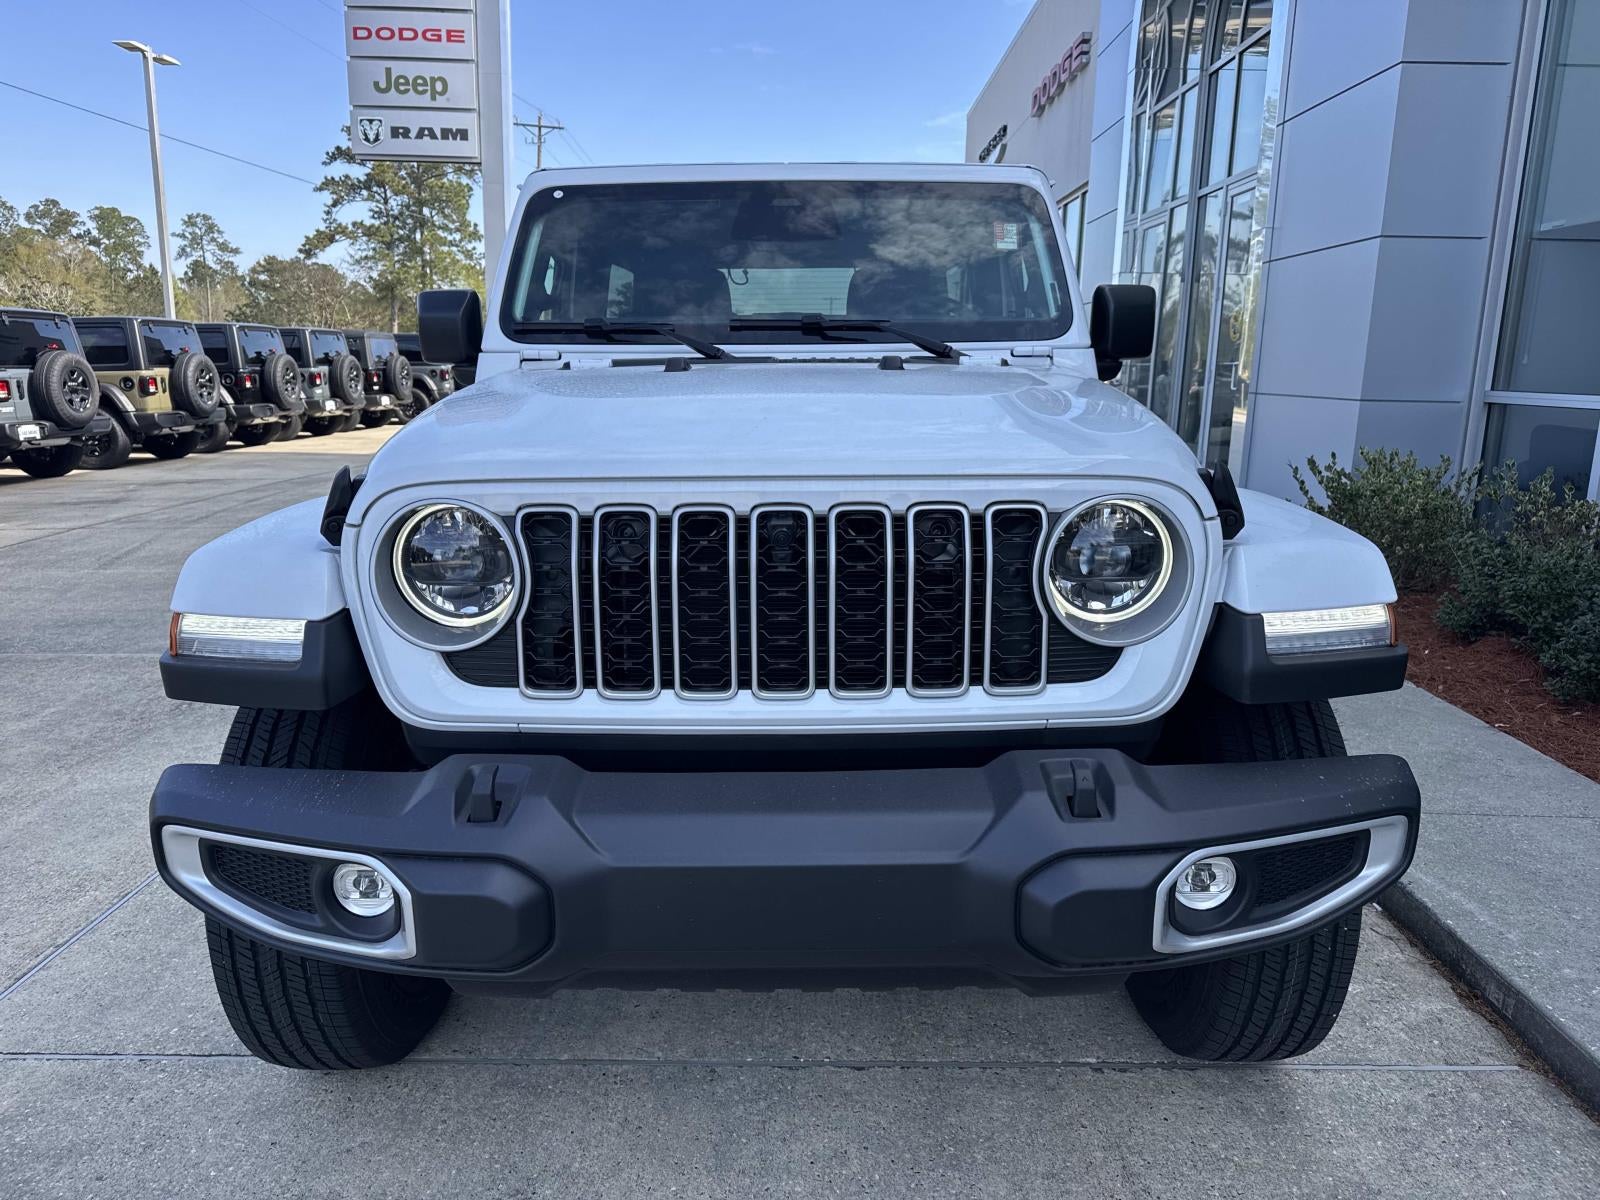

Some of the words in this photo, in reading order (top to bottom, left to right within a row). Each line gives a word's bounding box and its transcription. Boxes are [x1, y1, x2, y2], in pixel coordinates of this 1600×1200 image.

[352, 26, 466, 44] DODGE
[373, 67, 449, 102] Jeep
[1031, 32, 1092, 118] DODGE
[390, 126, 469, 142] RAM
